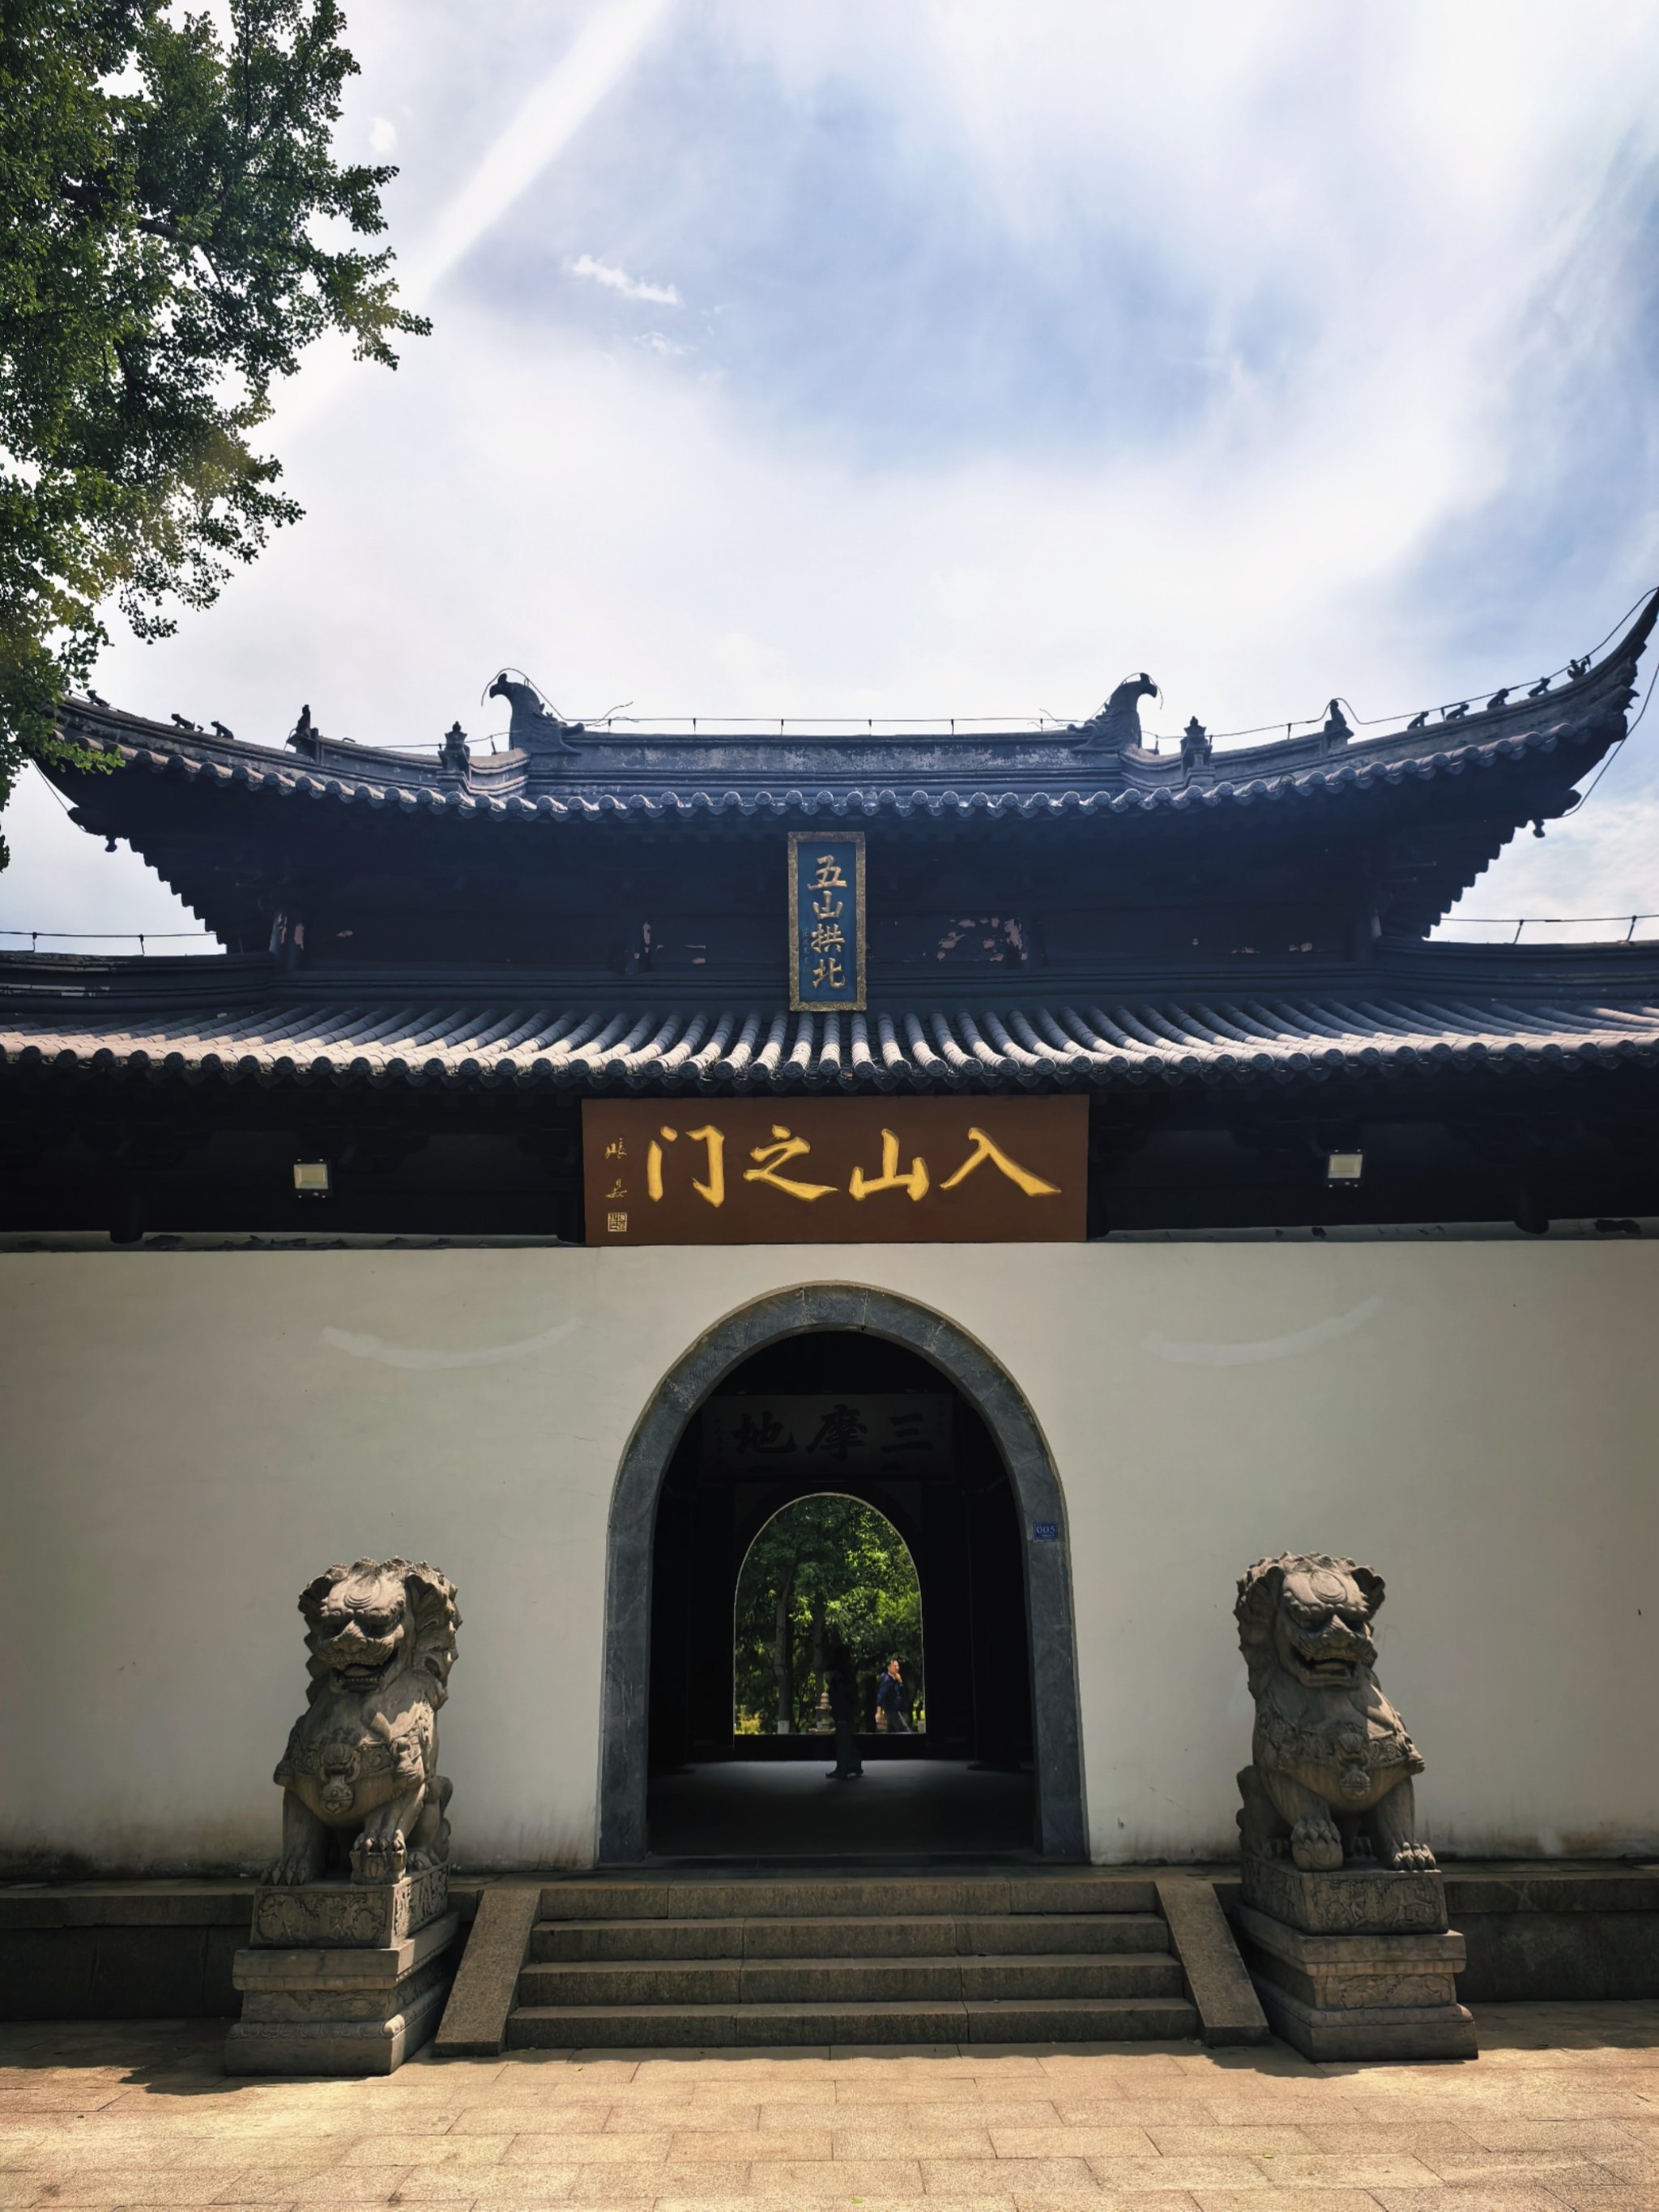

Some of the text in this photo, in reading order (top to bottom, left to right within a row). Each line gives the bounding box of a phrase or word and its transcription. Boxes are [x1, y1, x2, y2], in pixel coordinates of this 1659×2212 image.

[807, 855, 848, 989] 五山拱北
[647, 1124, 1061, 1208] 入山之门
